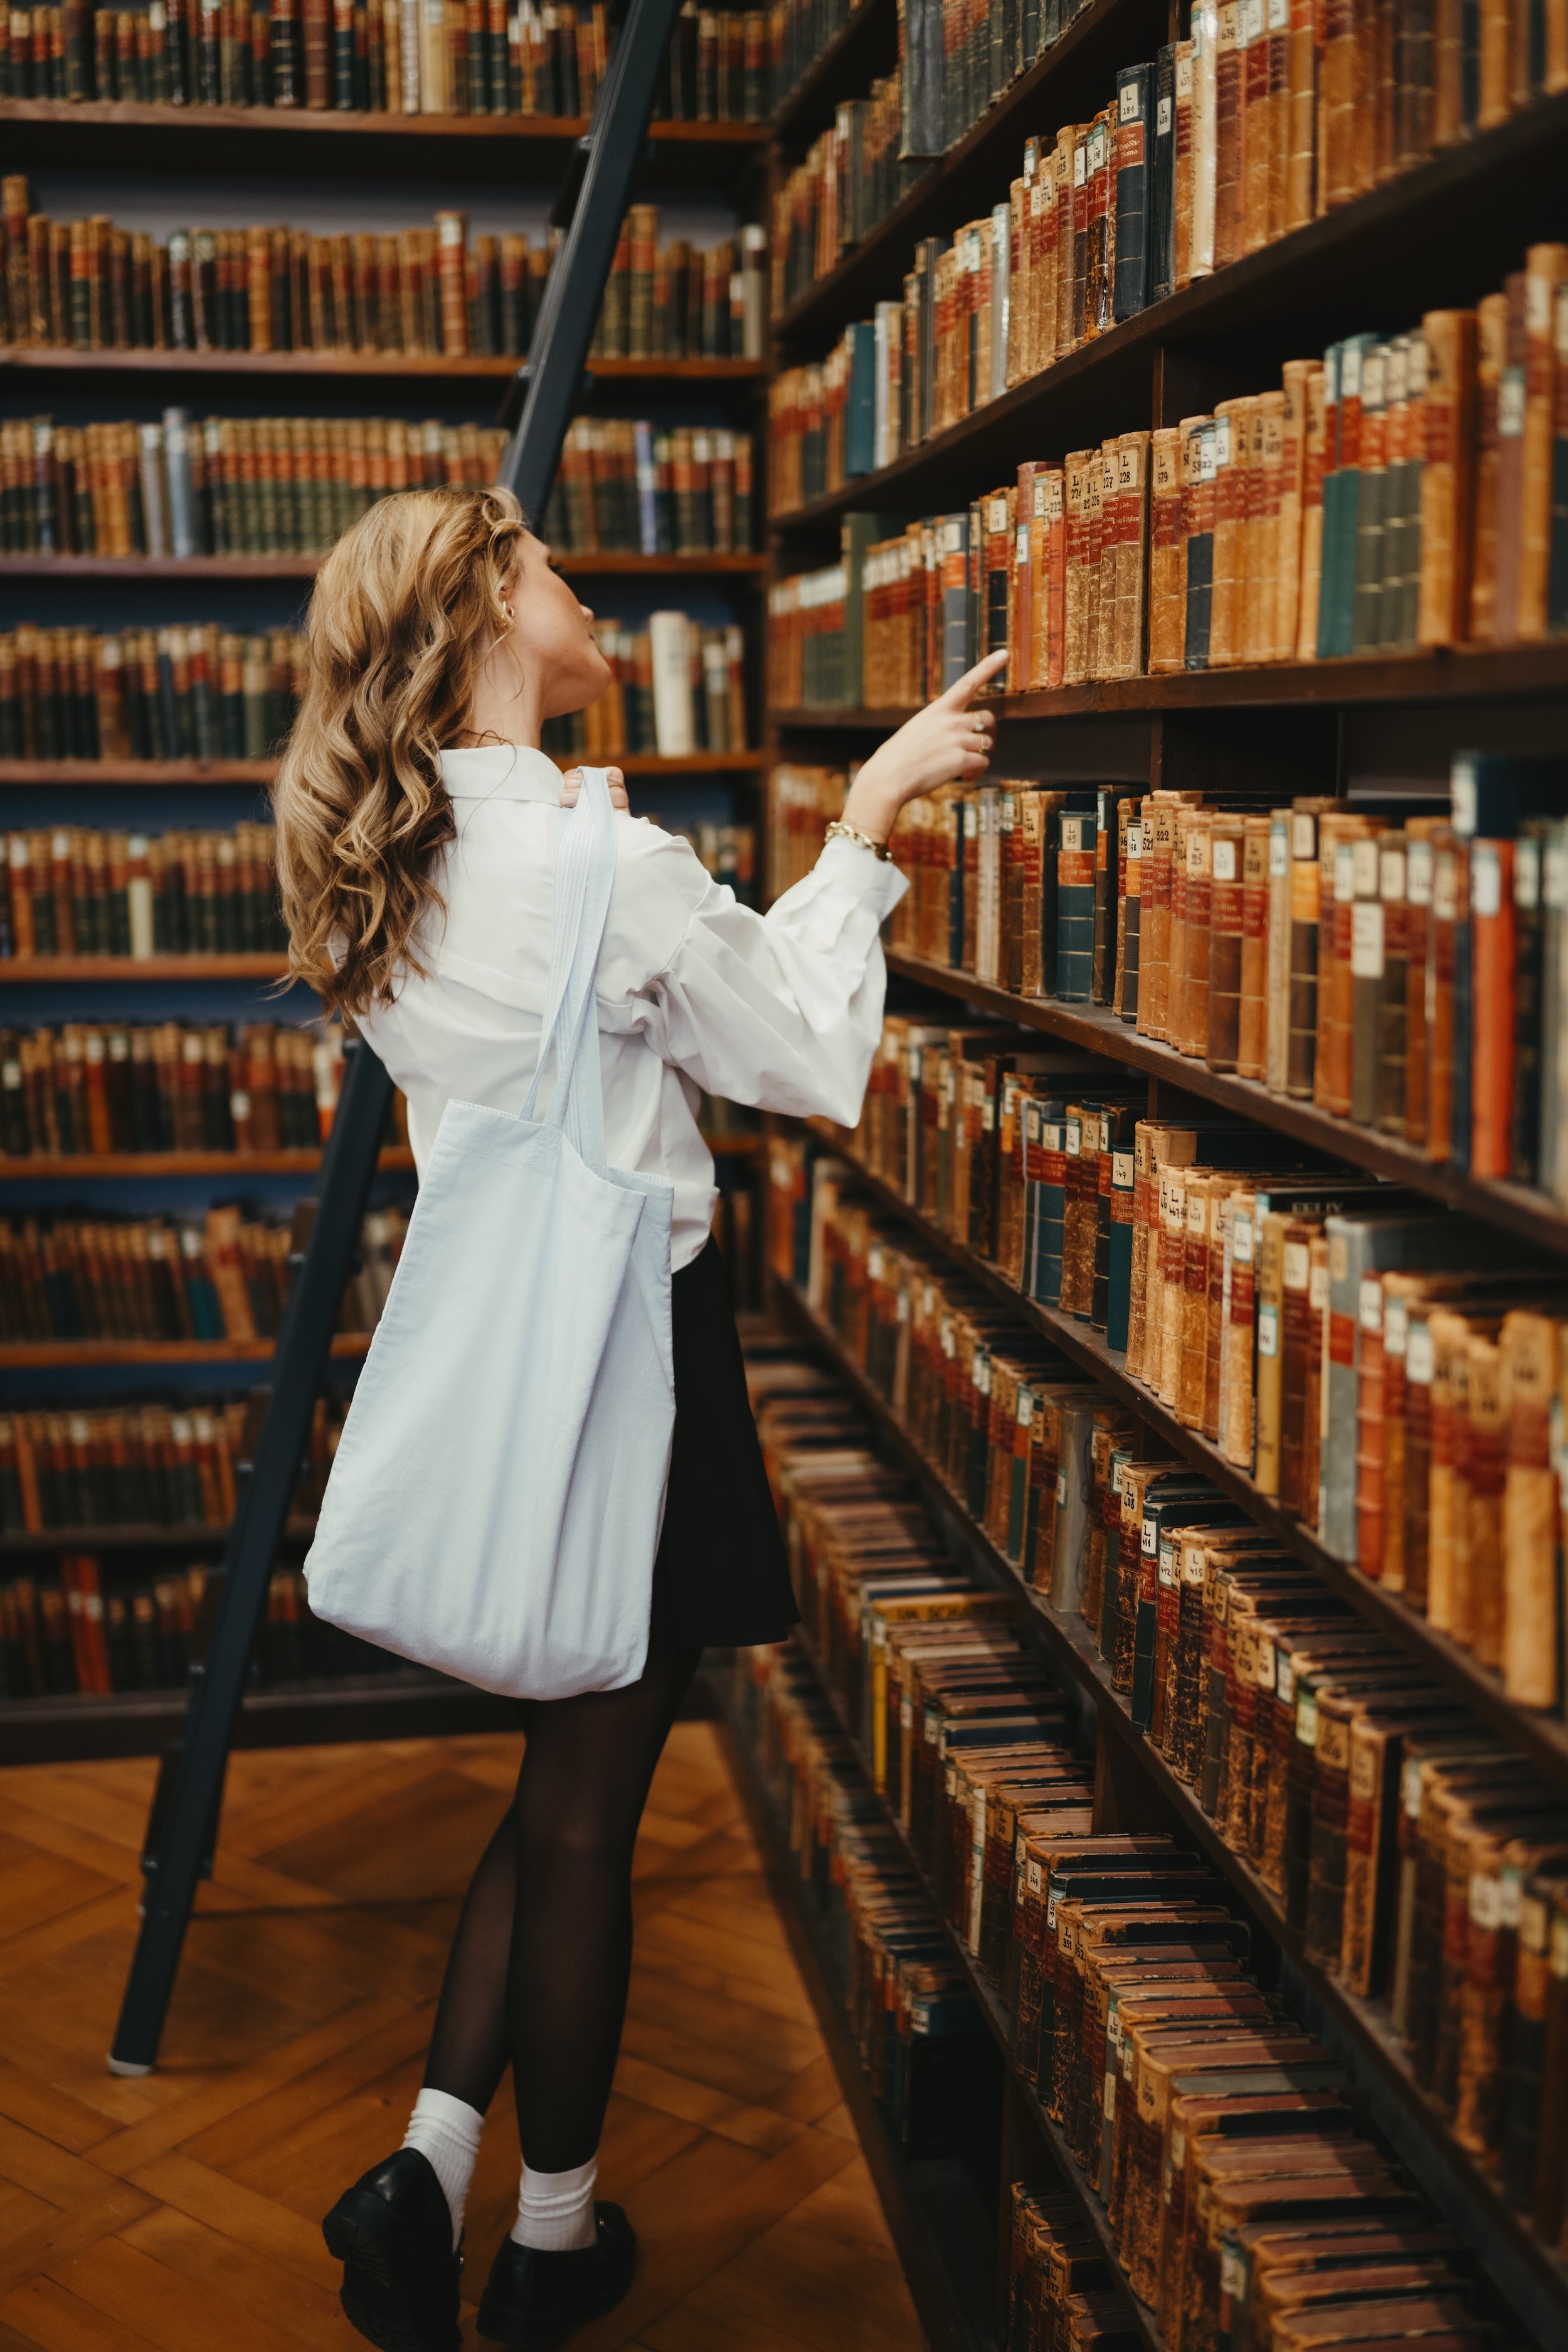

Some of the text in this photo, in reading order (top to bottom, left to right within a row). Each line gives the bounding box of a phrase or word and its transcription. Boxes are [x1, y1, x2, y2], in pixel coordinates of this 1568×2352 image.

[1225, 11, 1232, 24] L
[1221, 27, 1236, 40] 639
[1182, 65, 1187, 75] L
[1126, 90, 1131, 101] L
[1161, 103, 1165, 114] L
[1059, 148, 1066, 160] L
[1042, 178, 1048, 190] L
[1195, 444, 1200, 455] L
[1122, 455, 1129, 467] L
[1159, 455, 1165, 467] L
[1104, 462, 1110, 474] L
[1192, 461, 1201, 474] 58
[1073, 475, 1079, 486] L
[1103, 477, 1114, 489] 227
[1120, 471, 1130, 484] 228
[1052, 485, 1059, 496] L
[1093, 481, 1098, 492] L
[1050, 501, 1062, 513] 222
[1091, 495, 1100, 507] 226
[1025, 812, 1032, 822] L
[1160, 814, 1165, 826] L
[1068, 824, 1074, 834] L
[1120, 820, 1125, 832] L
[1144, 823, 1150, 834] L
[1131, 832, 1136, 842] L
[1156, 830, 1170, 842] 522
[1179, 832, 1184, 844] L
[1129, 843, 1137, 853] 198
[1143, 837, 1153, 851] 521
[1194, 837, 1200, 850] L
[1069, 1130, 1073, 1138] L
[1087, 1125, 1092, 1134] L
[1085, 1134, 1094, 1142] 147
[1152, 1148, 1157, 1160] L
[1119, 1158, 1124, 1167] L
[1116, 1170, 1126, 1180] 149
[1162, 1181, 1167, 1195] L
[1171, 1189, 1179, 1202] L
[1194, 1201, 1199, 1211] L
[1219, 1202, 1225, 1218] L
[1098, 1449, 1104, 1462] L
[1118, 1467, 1123, 1476] L
[1126, 1481, 1134, 1498] L
[1123, 1495, 1135, 1510] 408
[1144, 1524, 1151, 1537] L
[1142, 1537, 1151, 1548] 411
[1162, 1555, 1167, 1564] L
[1193, 1554, 1198, 1565] L
[1160, 1566, 1172, 1577] 412
[1189, 1567, 1203, 1577] 415
[1218, 1587, 1223, 1599] L
[1241, 1640, 1249, 1655] L
[1032, 1866, 1036, 1875] L
[1030, 1875, 1038, 1887] 349
[1064, 1926, 1071, 1938] L
[1063, 1938, 1072, 1951] 351
[1076, 1932, 1083, 1948] L
[1074, 1946, 1085, 1963] 352
[1085, 1972, 1091, 1985] L
[1096, 1990, 1101, 2003] L
[1113, 2016, 1118, 2027] L
[1108, 2026, 1118, 2035] 35
[1145, 2074, 1153, 2090] L
[1050, 2266, 1057, 2281] L
